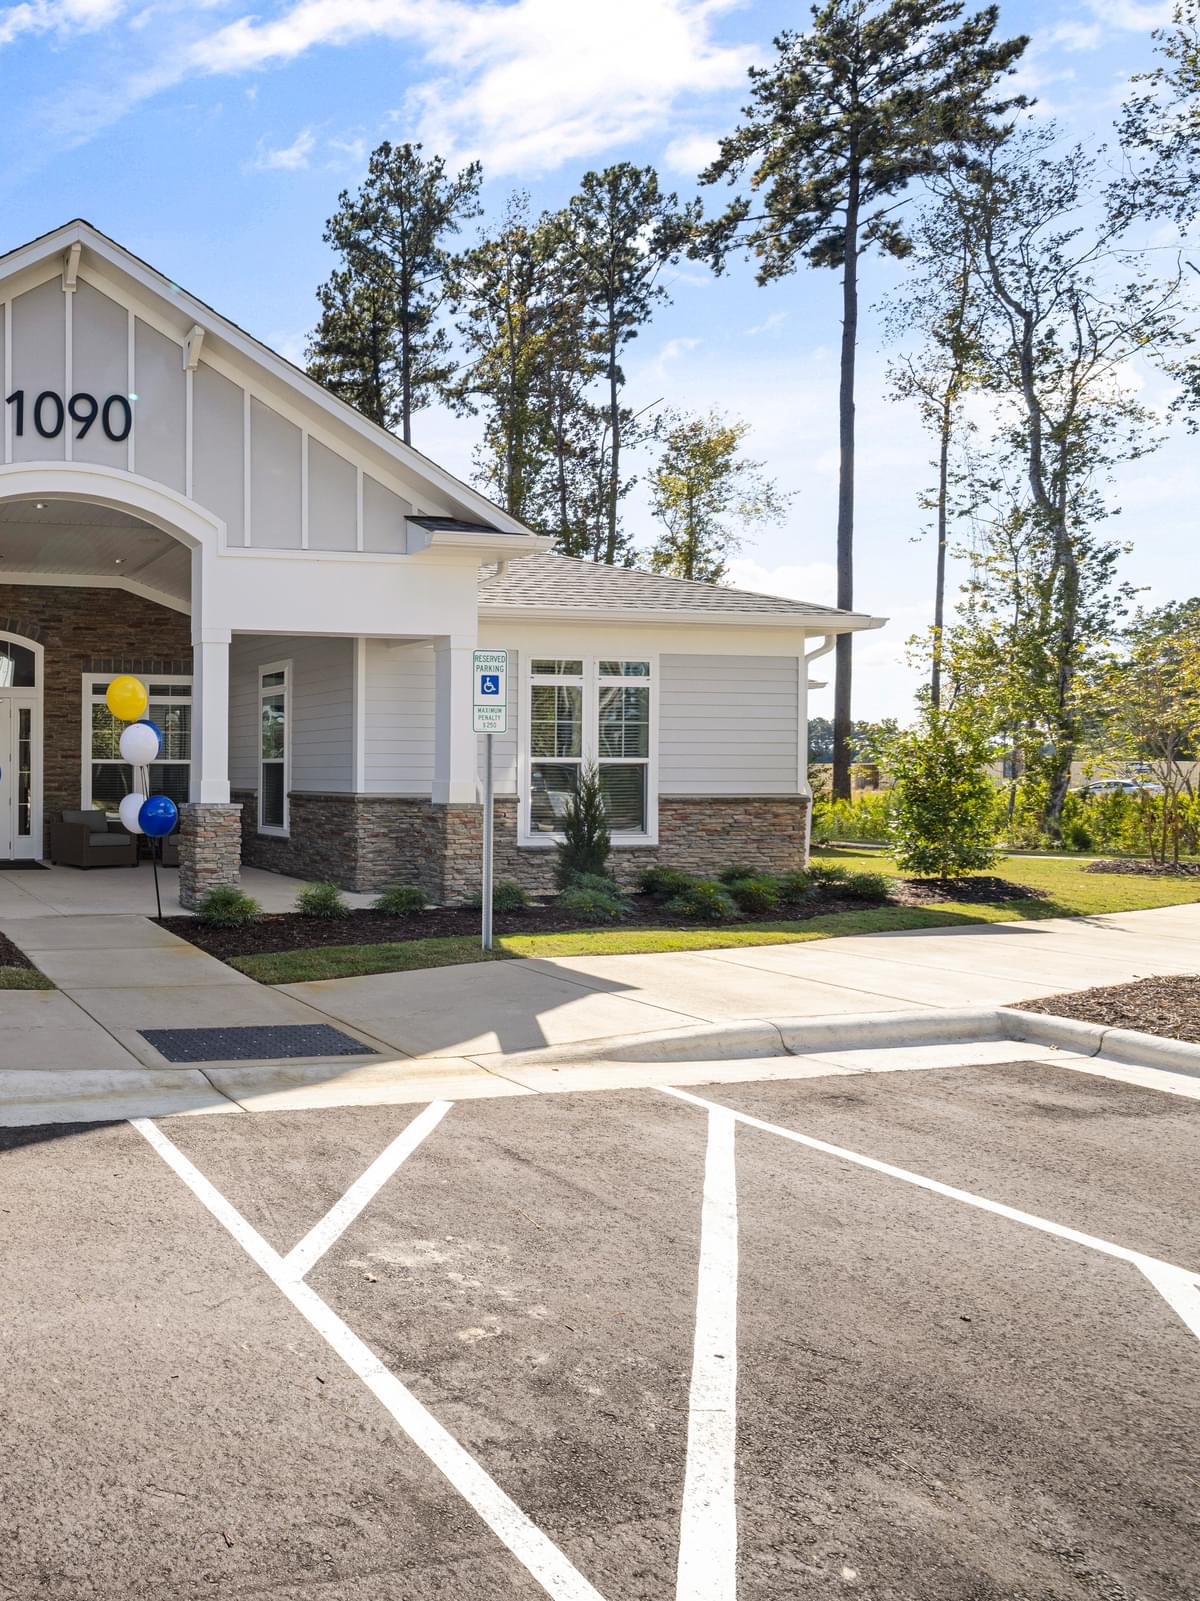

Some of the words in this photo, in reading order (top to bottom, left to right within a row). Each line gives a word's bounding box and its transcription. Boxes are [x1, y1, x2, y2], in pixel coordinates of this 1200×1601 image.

[5, 390, 132, 442] 1090
[474, 655, 506, 663] RESERVED
[476, 664, 504, 672] PARKING
